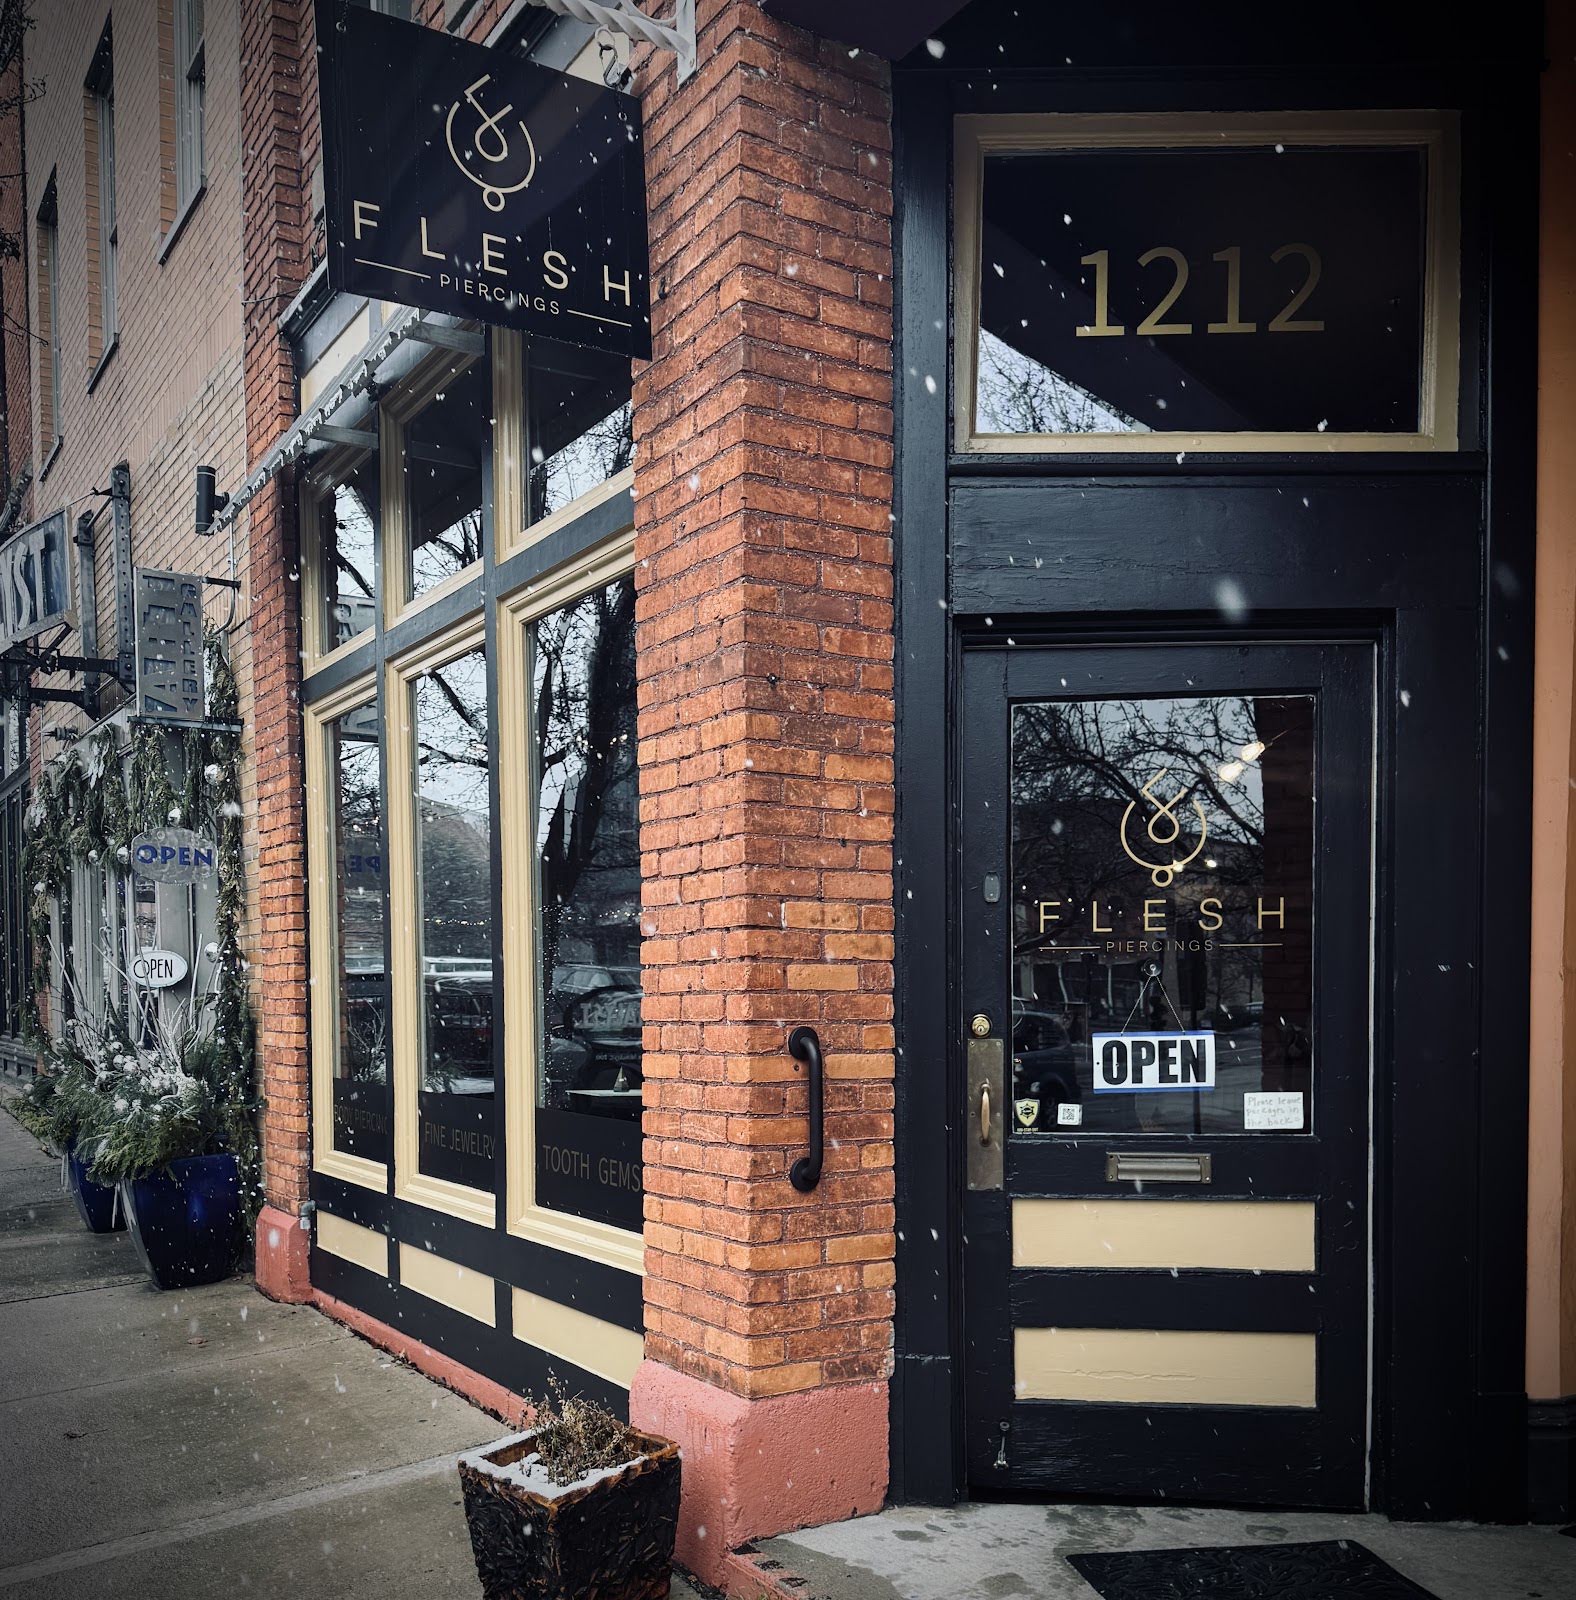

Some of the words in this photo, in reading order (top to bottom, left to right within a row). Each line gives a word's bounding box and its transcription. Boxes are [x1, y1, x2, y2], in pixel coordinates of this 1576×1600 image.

[352, 199, 632, 307] FLESH
[439, 273, 561, 315] PIERCINGS
[1075, 242, 1325, 338] 1212
[0, 527, 46, 642] YST
[180, 583, 199, 712] GALLERY
[136, 844, 213, 867] OPEN
[1039, 896, 1286, 934] FLESH
[1105, 938, 1214, 953] PIERCINGS
[133, 958, 173, 979] OPEN
[1102, 1038, 1207, 1085] OPEN
[1248, 1096, 1273, 1106] Please
[424, 1121, 446, 1148] FINE
[449, 1128, 496, 1159] JEWELRY
[542, 1145, 590, 1180] TOOTH
[598, 1157, 641, 1193] GEMS
